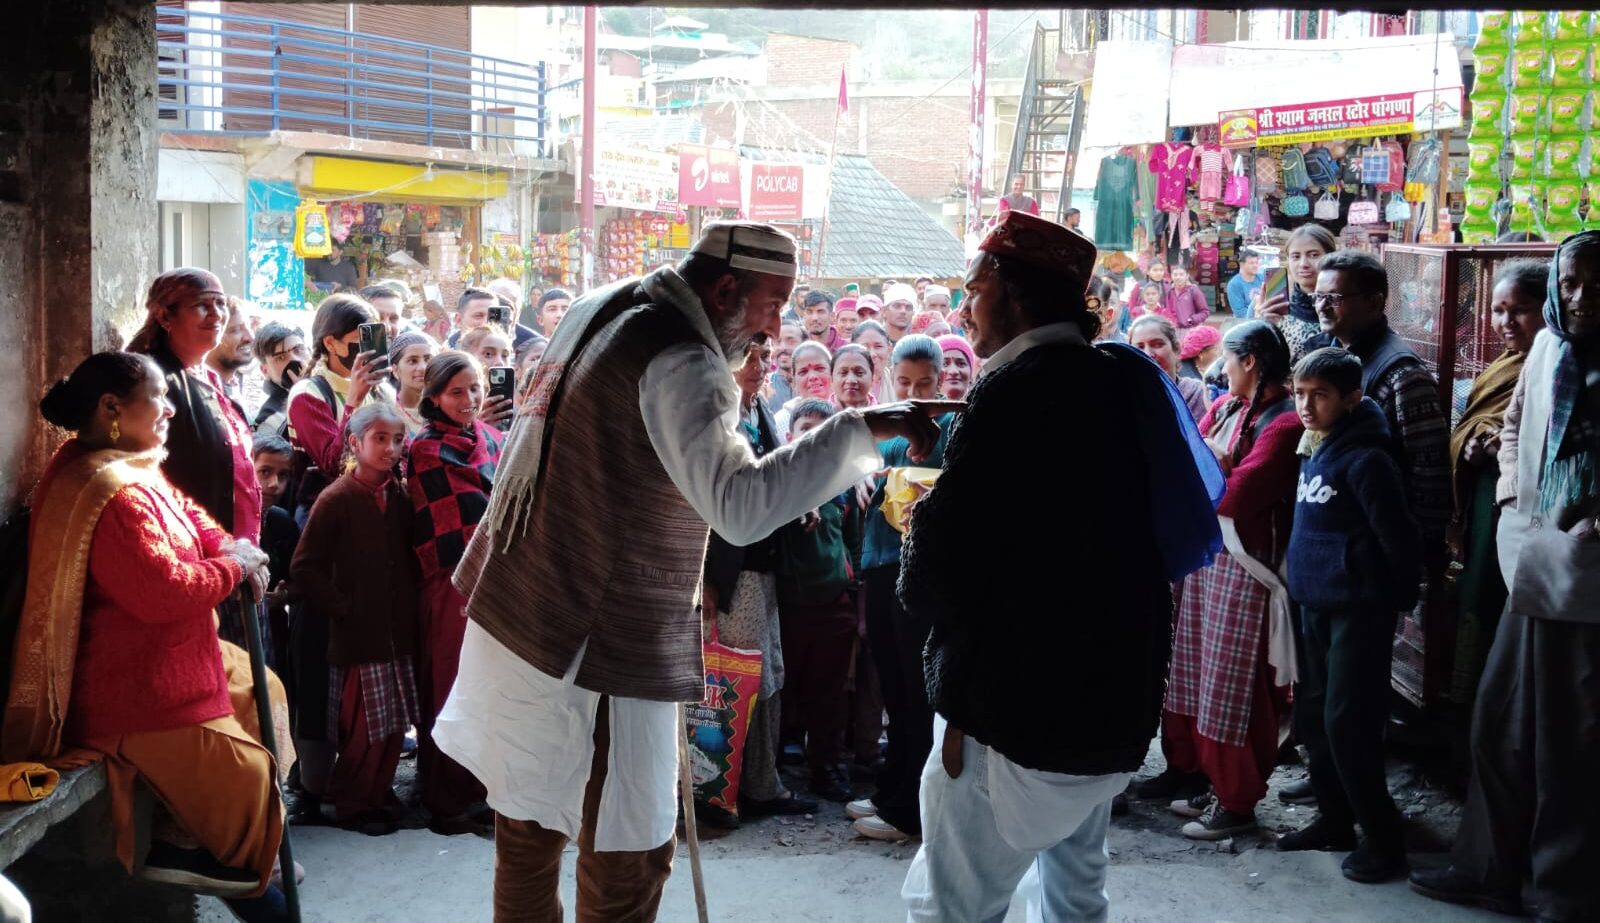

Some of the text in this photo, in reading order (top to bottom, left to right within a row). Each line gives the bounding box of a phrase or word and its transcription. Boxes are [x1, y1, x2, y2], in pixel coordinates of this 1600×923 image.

[1259, 109, 1274, 128] श्री
[1275, 110, 1305, 127] श्याम
[1307, 105, 1344, 123] जनरल
[1345, 100, 1369, 120] स्टोर
[1371, 96, 1412, 117] पांगणा
[711, 169, 730, 184] airtel
[757, 175, 798, 192] POLYCAB
